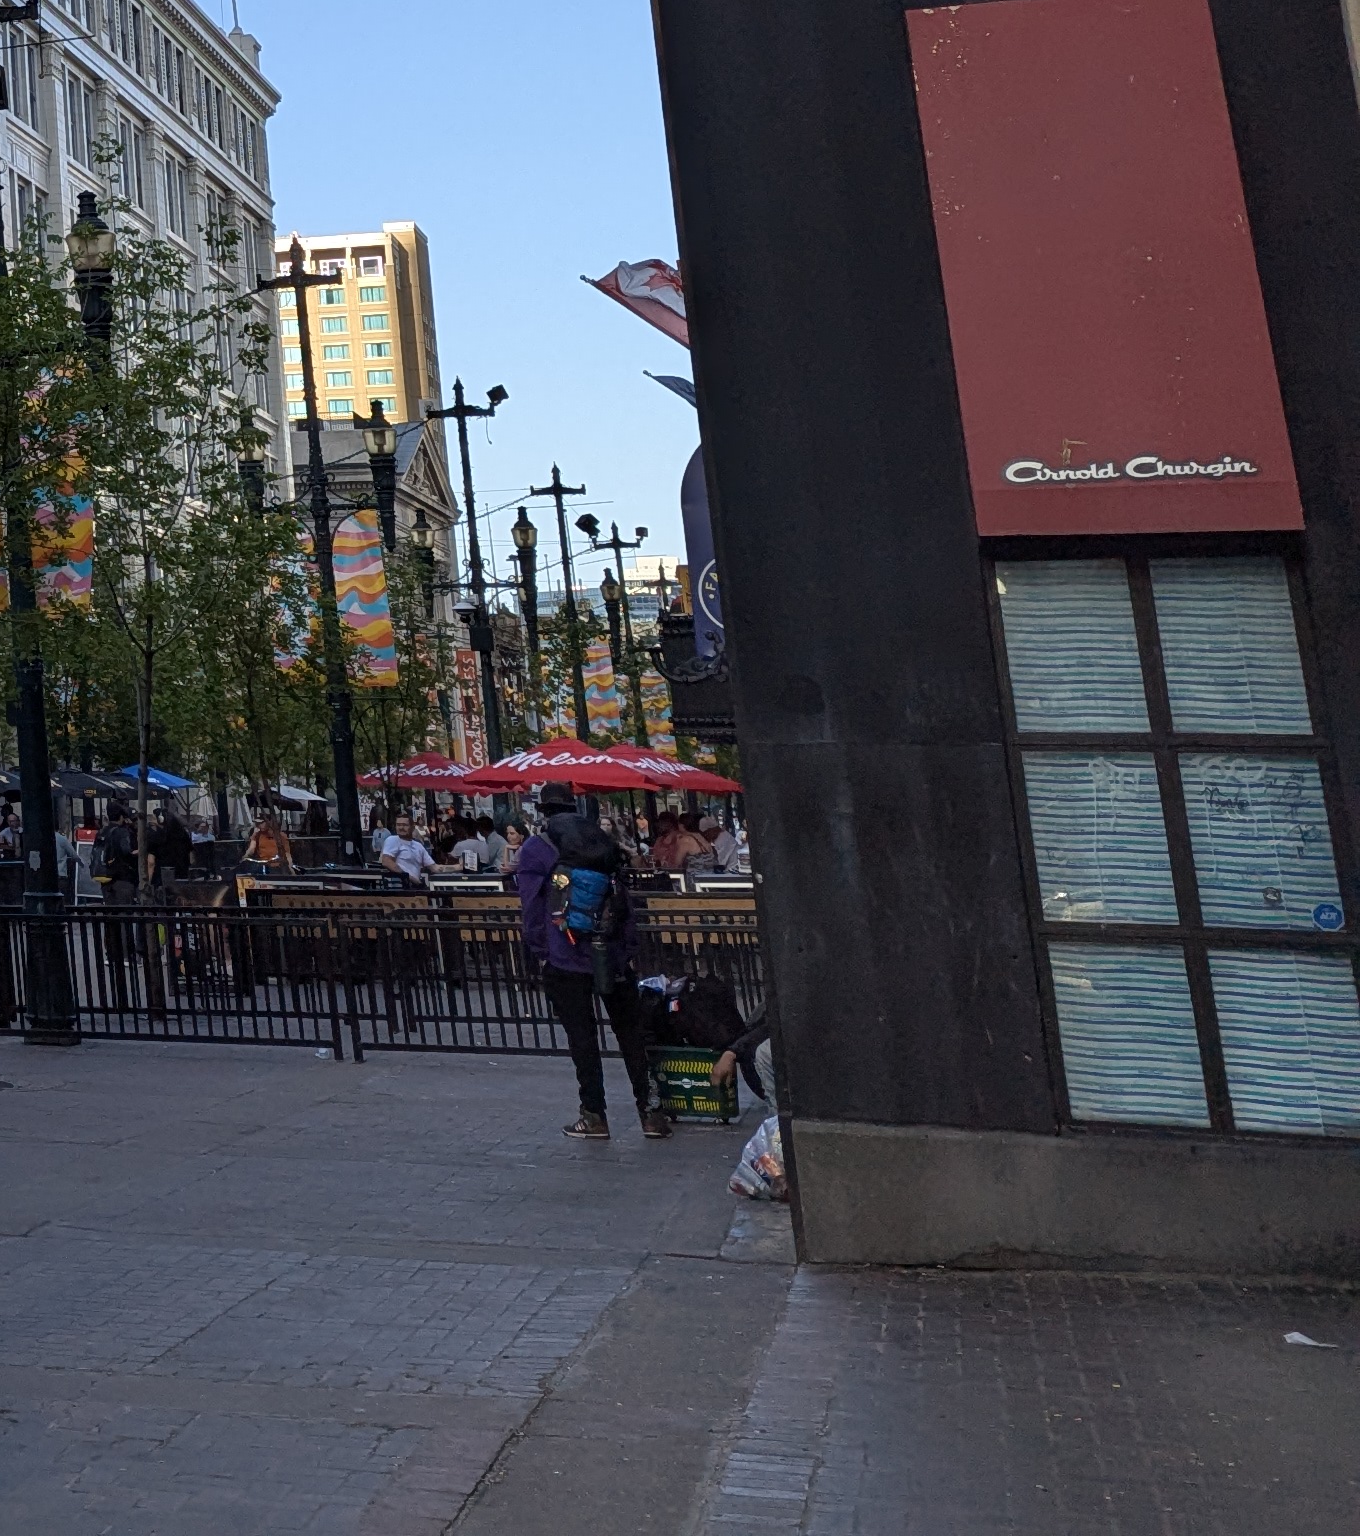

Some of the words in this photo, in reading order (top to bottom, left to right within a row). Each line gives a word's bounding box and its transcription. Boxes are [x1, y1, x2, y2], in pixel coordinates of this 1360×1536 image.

[1126, 456, 1257, 478] Churgin
[492, 751, 615, 772] Molson
[1321, 911, 1337, 920] ADT
